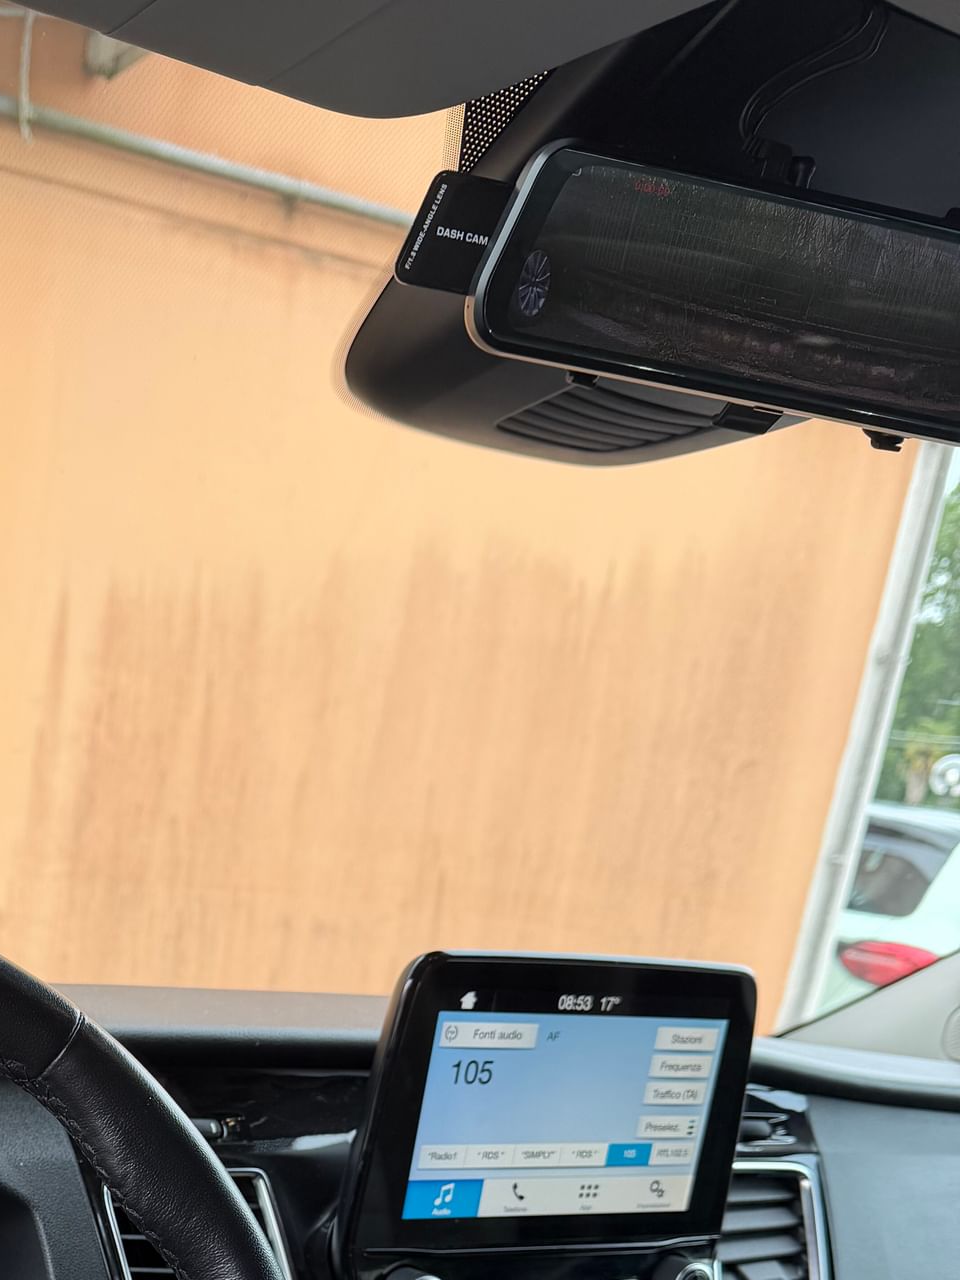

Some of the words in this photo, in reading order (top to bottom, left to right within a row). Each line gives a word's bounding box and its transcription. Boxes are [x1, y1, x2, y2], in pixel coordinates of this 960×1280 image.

[414, 204, 438, 252] WIDE-ANGLE
[436, 183, 448, 205] LENS
[436, 226, 464, 241] DASH
[465, 232, 489, 246] CAM
[558, 995, 592, 1011] 08:53
[600, 996, 622, 1011] 17°
[472, 1028, 496, 1040] Fonti
[497, 1029, 523, 1041] audio
[546, 1031, 561, 1041] AF
[451, 1060, 494, 1085] 105
